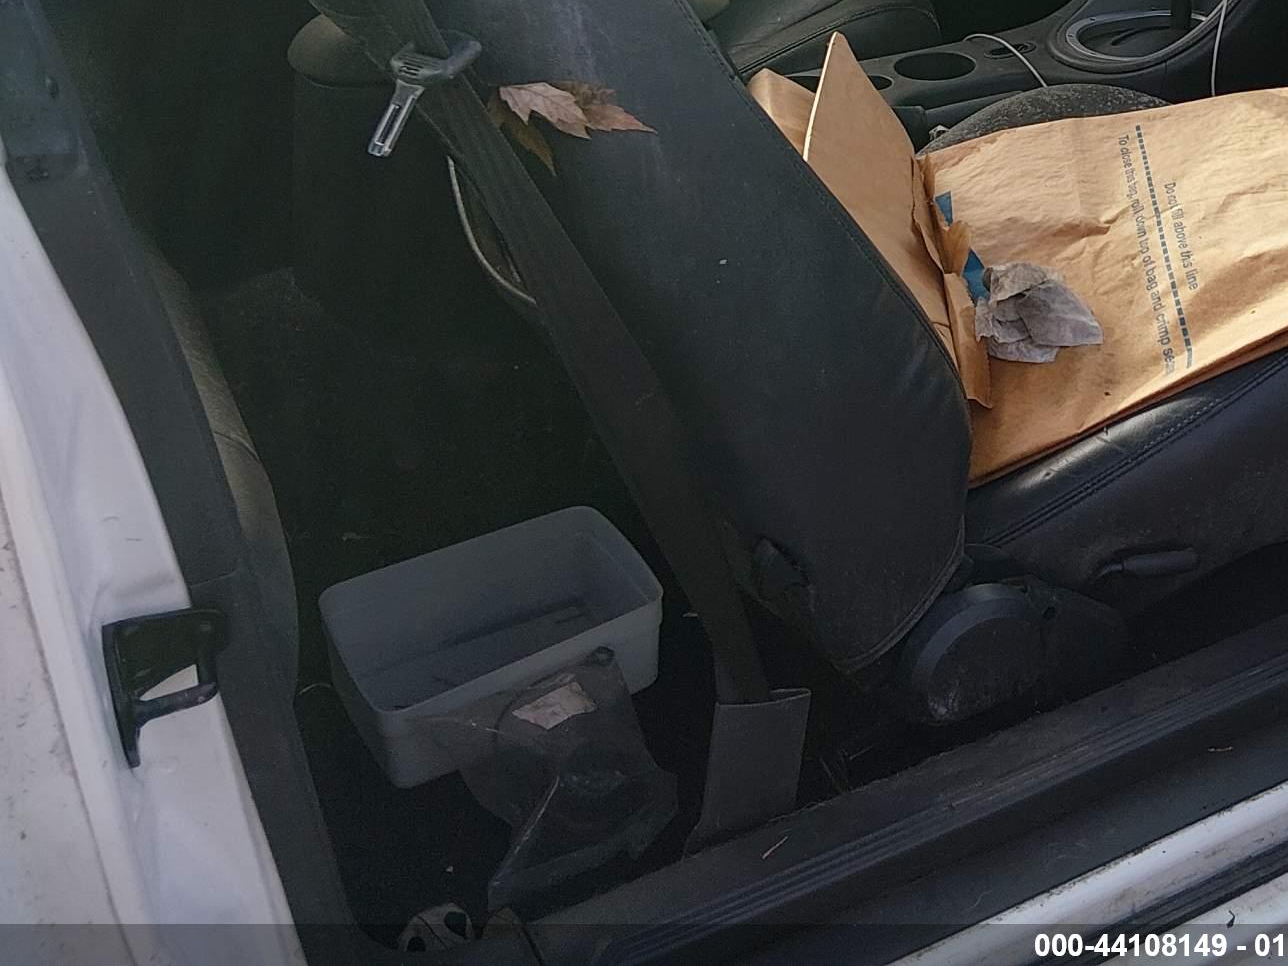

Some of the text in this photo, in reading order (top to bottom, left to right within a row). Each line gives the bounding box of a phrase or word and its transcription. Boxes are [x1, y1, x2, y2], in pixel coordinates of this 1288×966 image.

[1118, 134, 1130, 147] To
[1120, 147, 1133, 170] close
[1164, 181, 1177, 195] Do
[1131, 198, 1145, 215] roll
[1173, 221, 1188, 250] above
[1141, 253, 1156, 268] of
[1180, 249, 1194, 269] this
[1145, 265, 1158, 292] bag
[1185, 268, 1200, 291] line
[1150, 290, 1166, 312] and
[1155, 312, 1172, 347] crimp
